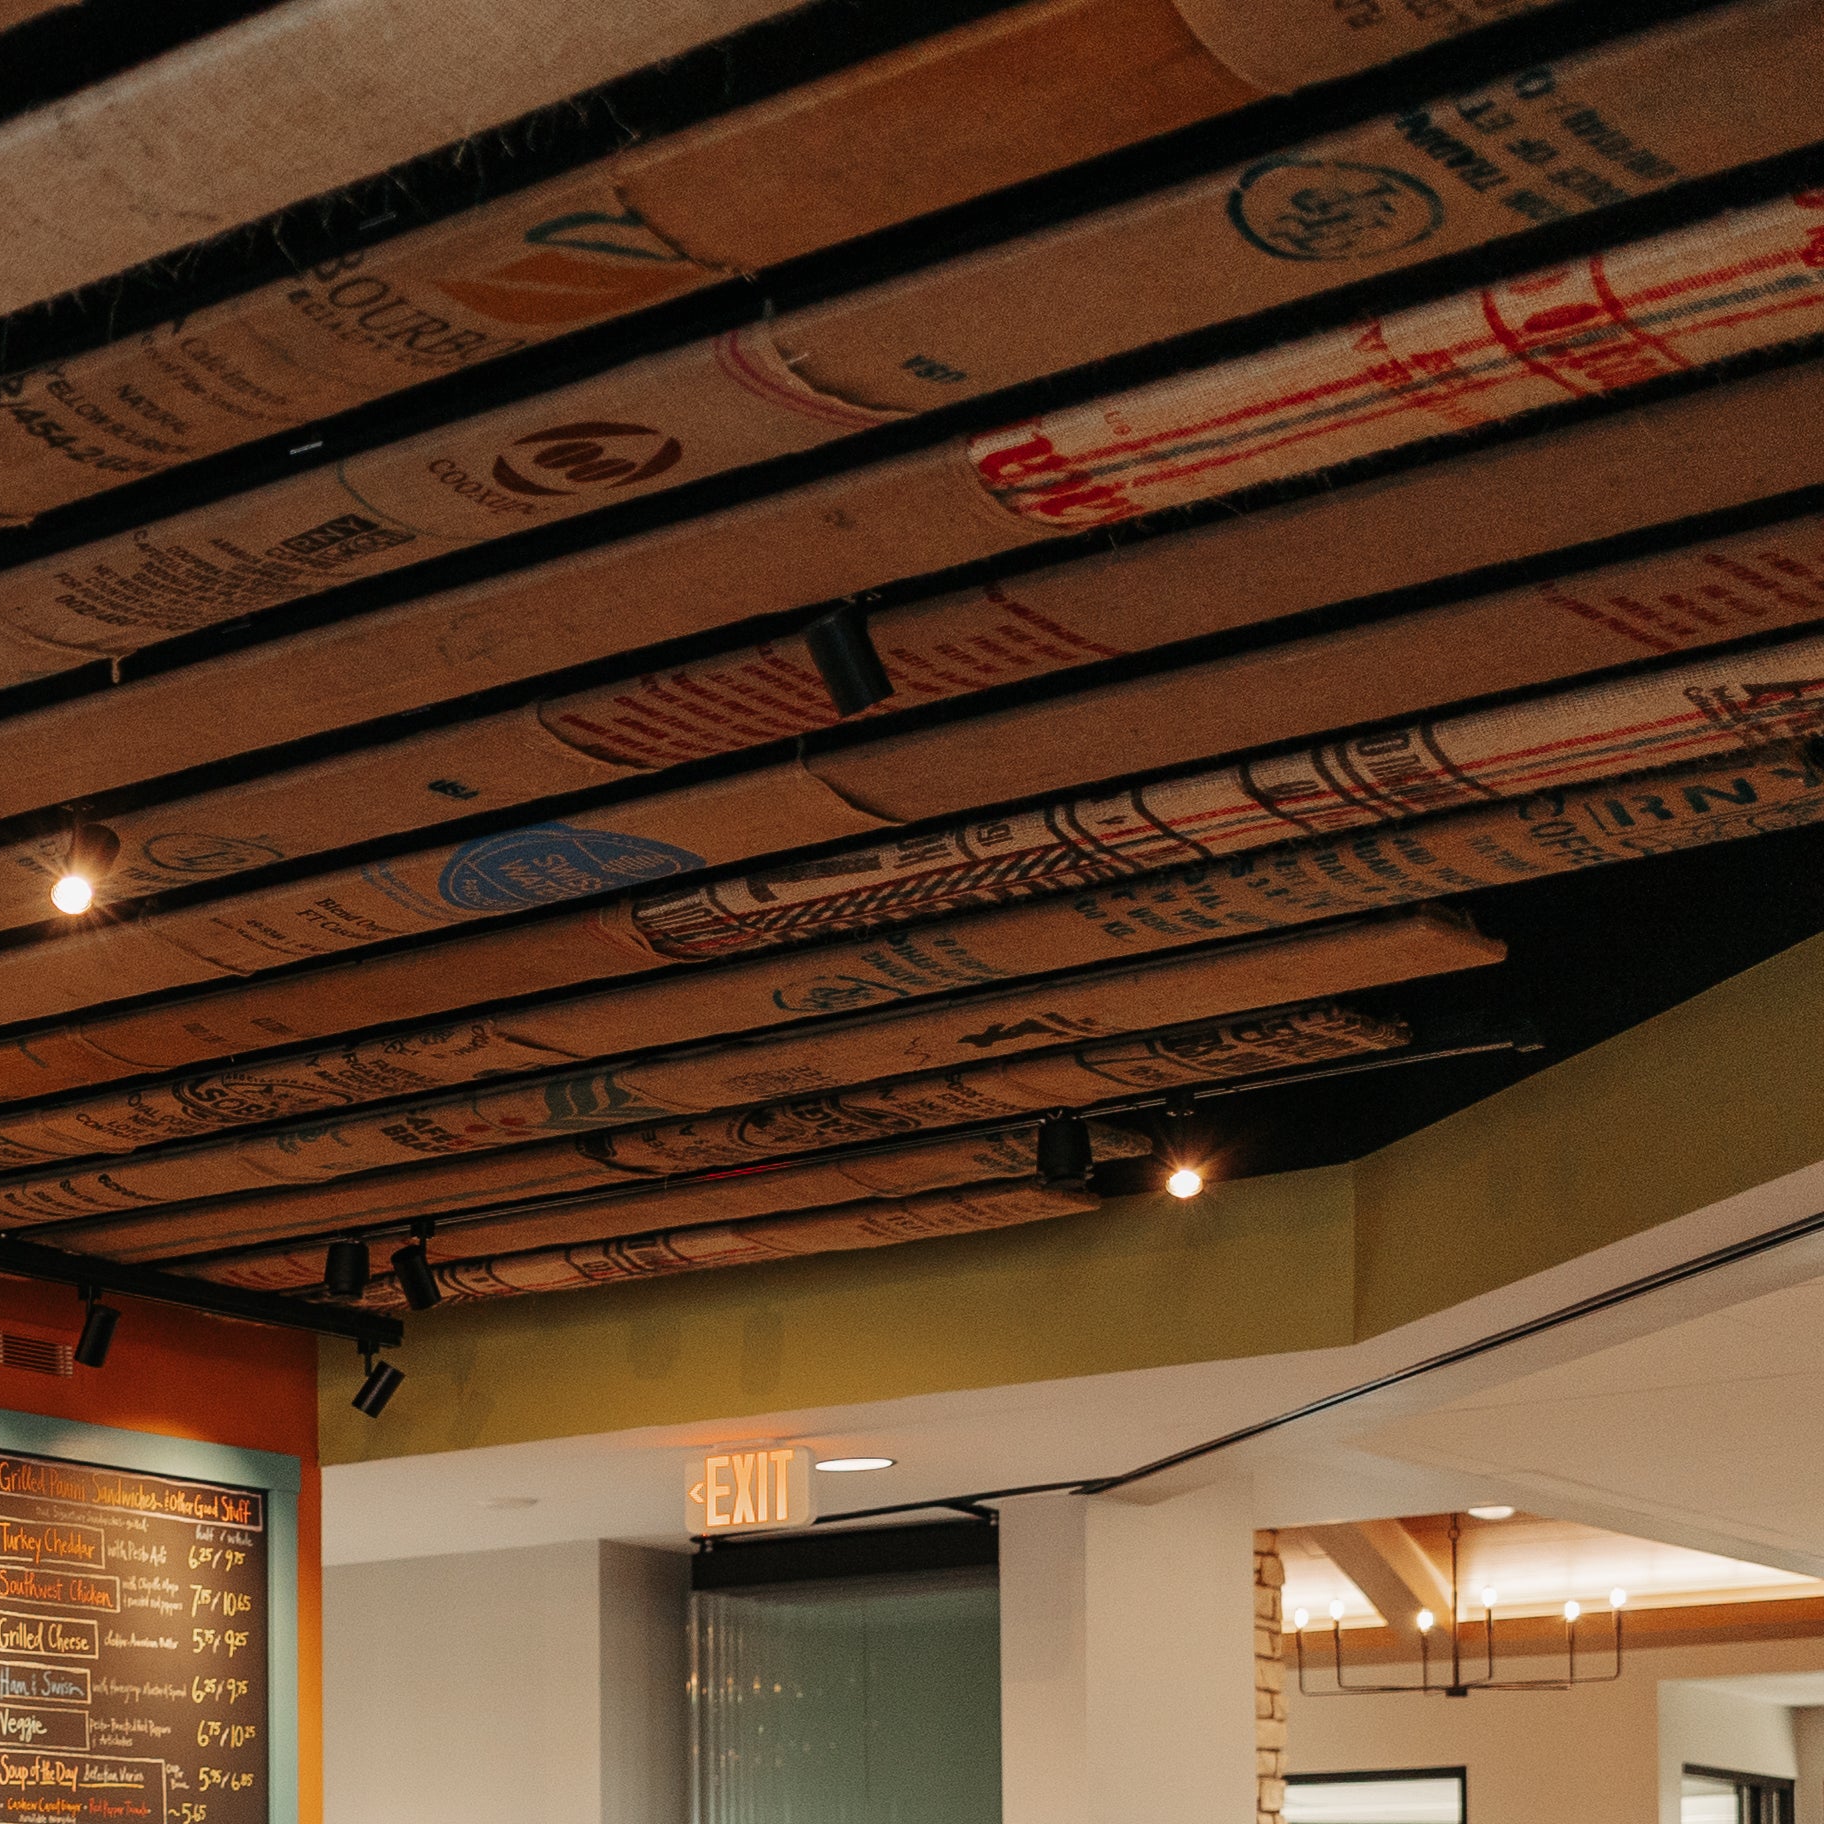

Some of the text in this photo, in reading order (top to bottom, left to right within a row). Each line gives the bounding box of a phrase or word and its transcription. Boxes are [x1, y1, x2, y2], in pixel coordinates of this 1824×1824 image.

[705, 1448, 794, 1528] EXIT
[48, 1624, 90, 1651] Cheese
[0, 1709, 47, 1743] Veggie
